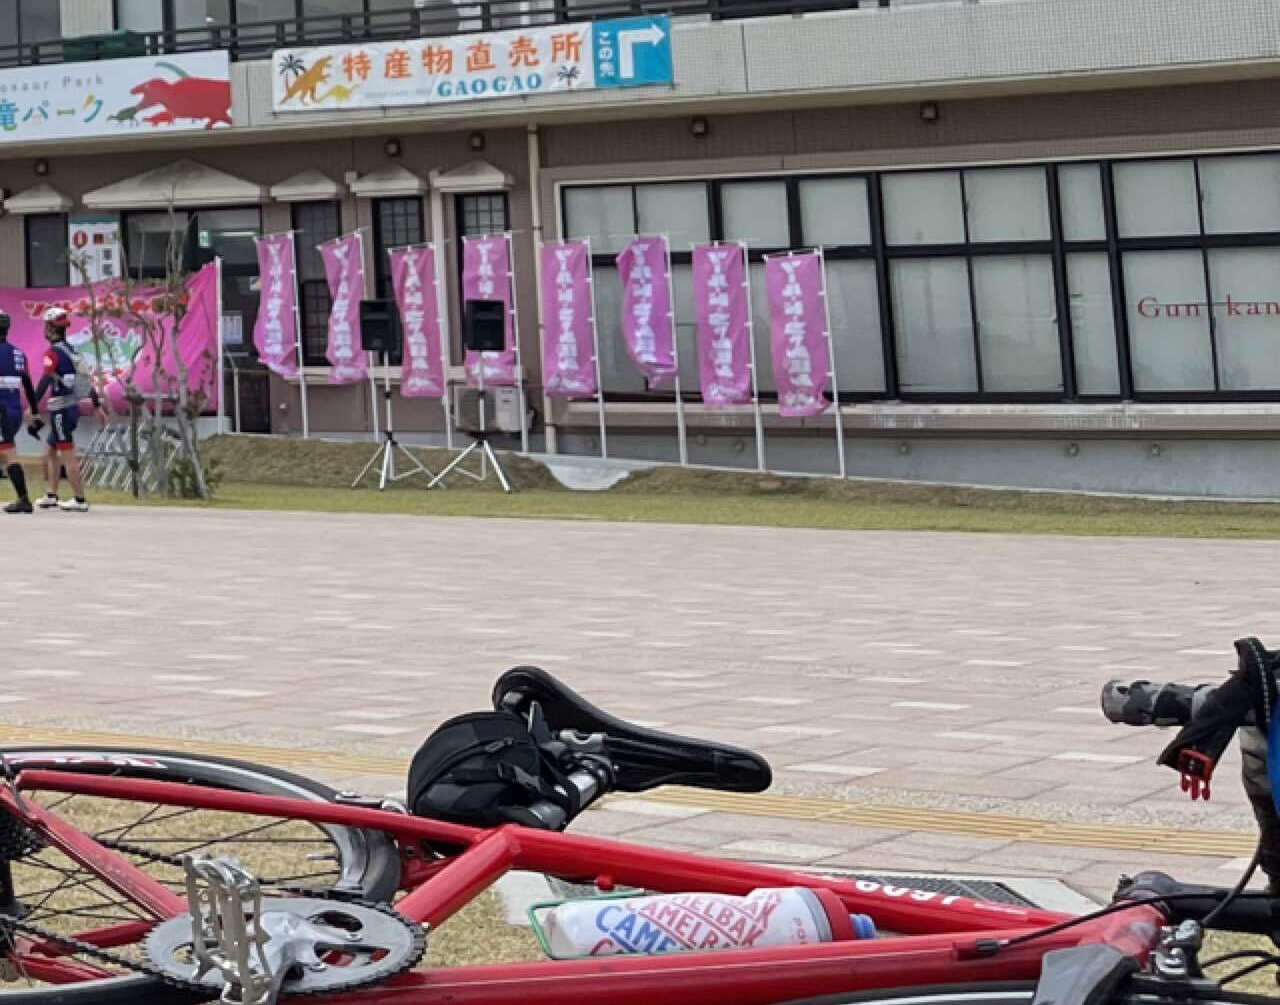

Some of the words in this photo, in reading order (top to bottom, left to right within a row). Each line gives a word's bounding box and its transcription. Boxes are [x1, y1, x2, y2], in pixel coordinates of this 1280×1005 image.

[342, 31, 583, 82] 特産物直売所
[62, 74, 104, 88] Park
